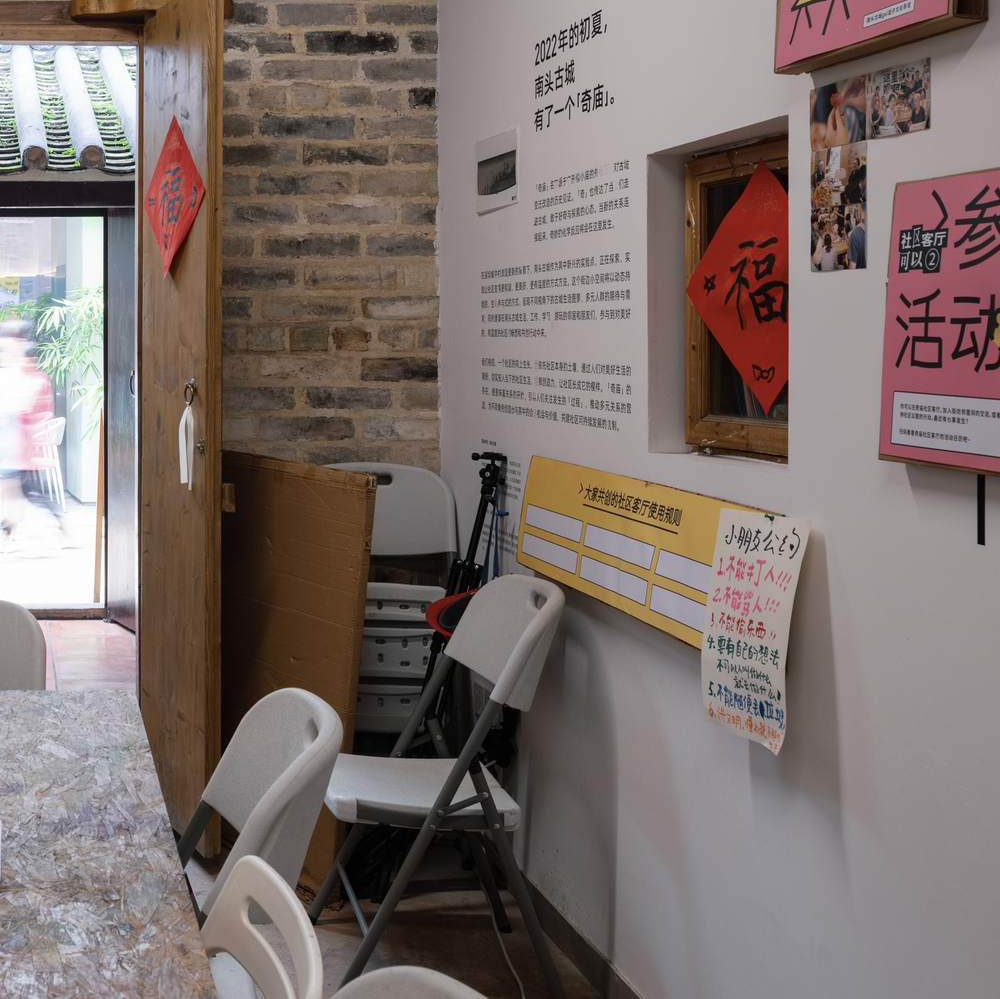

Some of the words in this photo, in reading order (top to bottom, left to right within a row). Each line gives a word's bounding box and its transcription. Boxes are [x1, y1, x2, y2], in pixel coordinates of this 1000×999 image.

[534, 59, 576, 100] 南头古城
[158, 167, 182, 227] 福
[900, 227, 947, 250] 社区客厅
[724, 237, 789, 331] 福
[895, 288, 1000, 374] 活动
[584, 484, 683, 527] 大家共创的社区客厅使用规则
[725, 525, 801, 560] 小朋友公约
